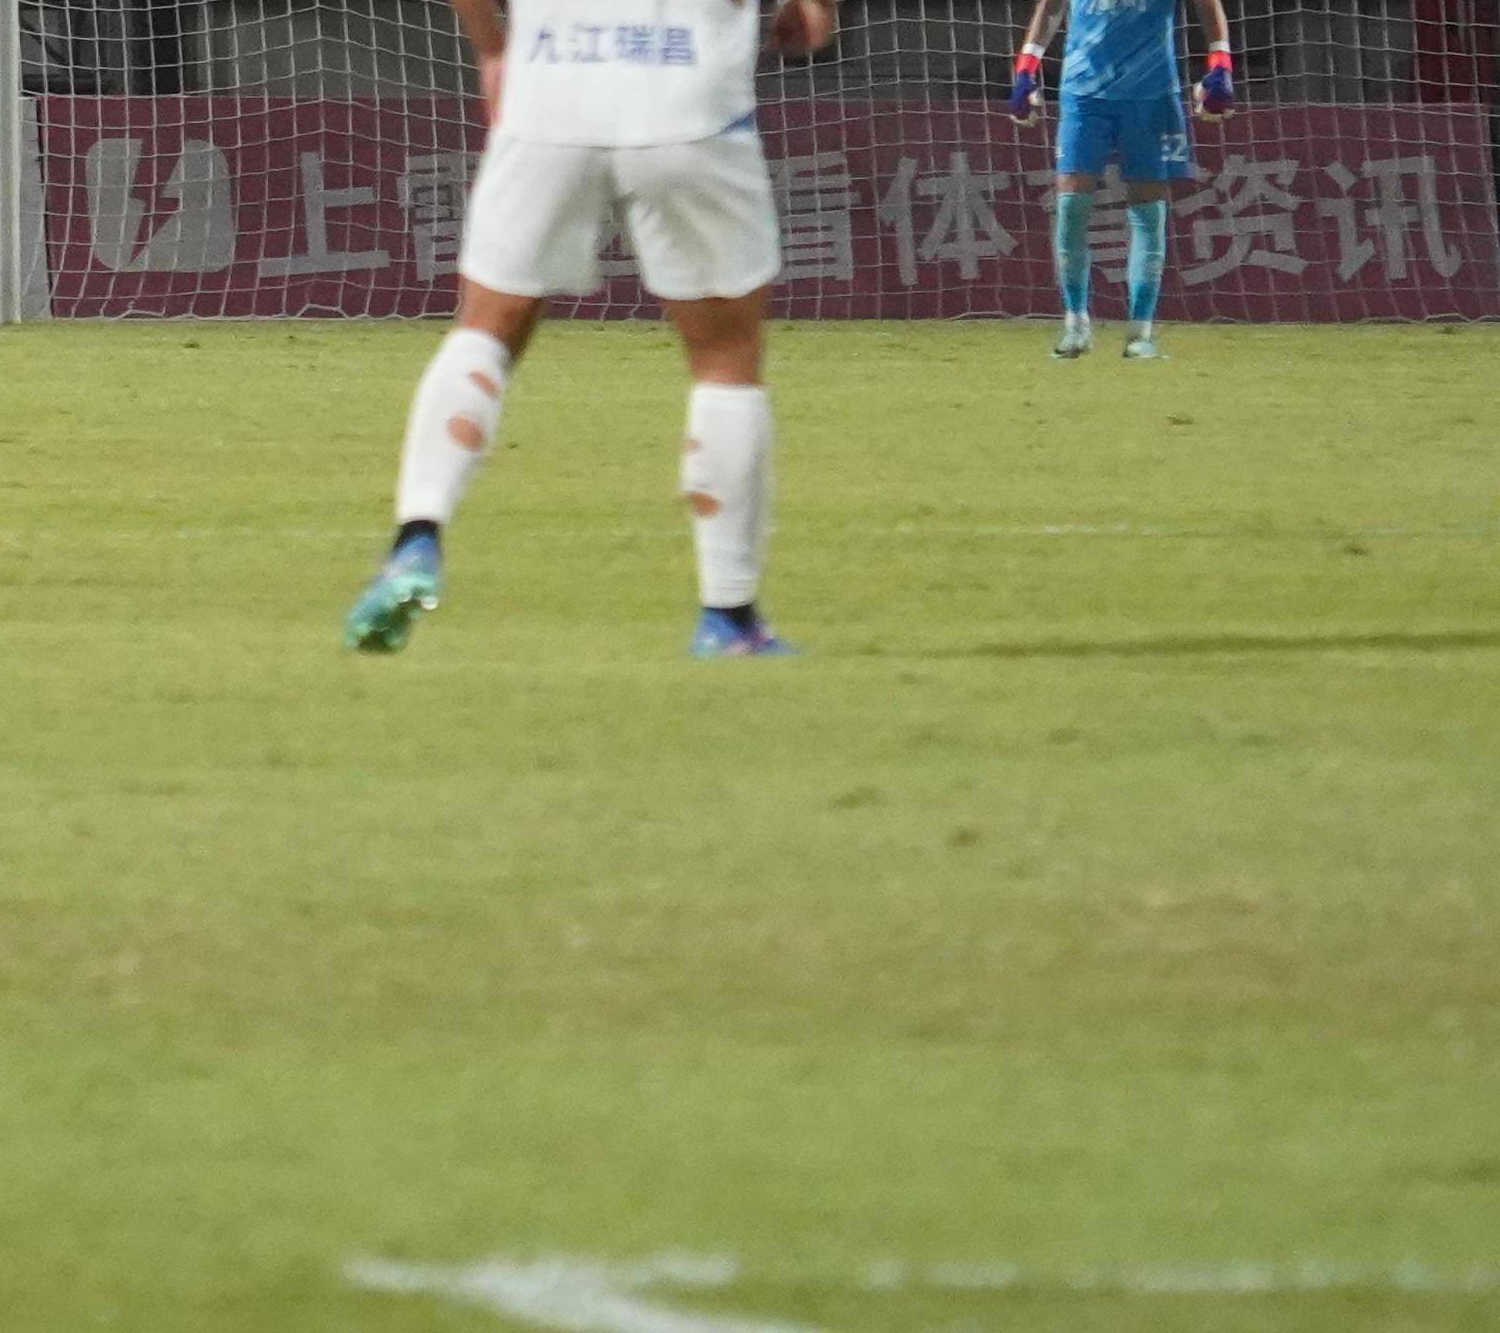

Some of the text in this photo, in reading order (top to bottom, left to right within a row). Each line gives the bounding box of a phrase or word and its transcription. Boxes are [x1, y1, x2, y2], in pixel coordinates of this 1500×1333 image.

[257, 150, 1462, 290] 上雷看体育资讯
